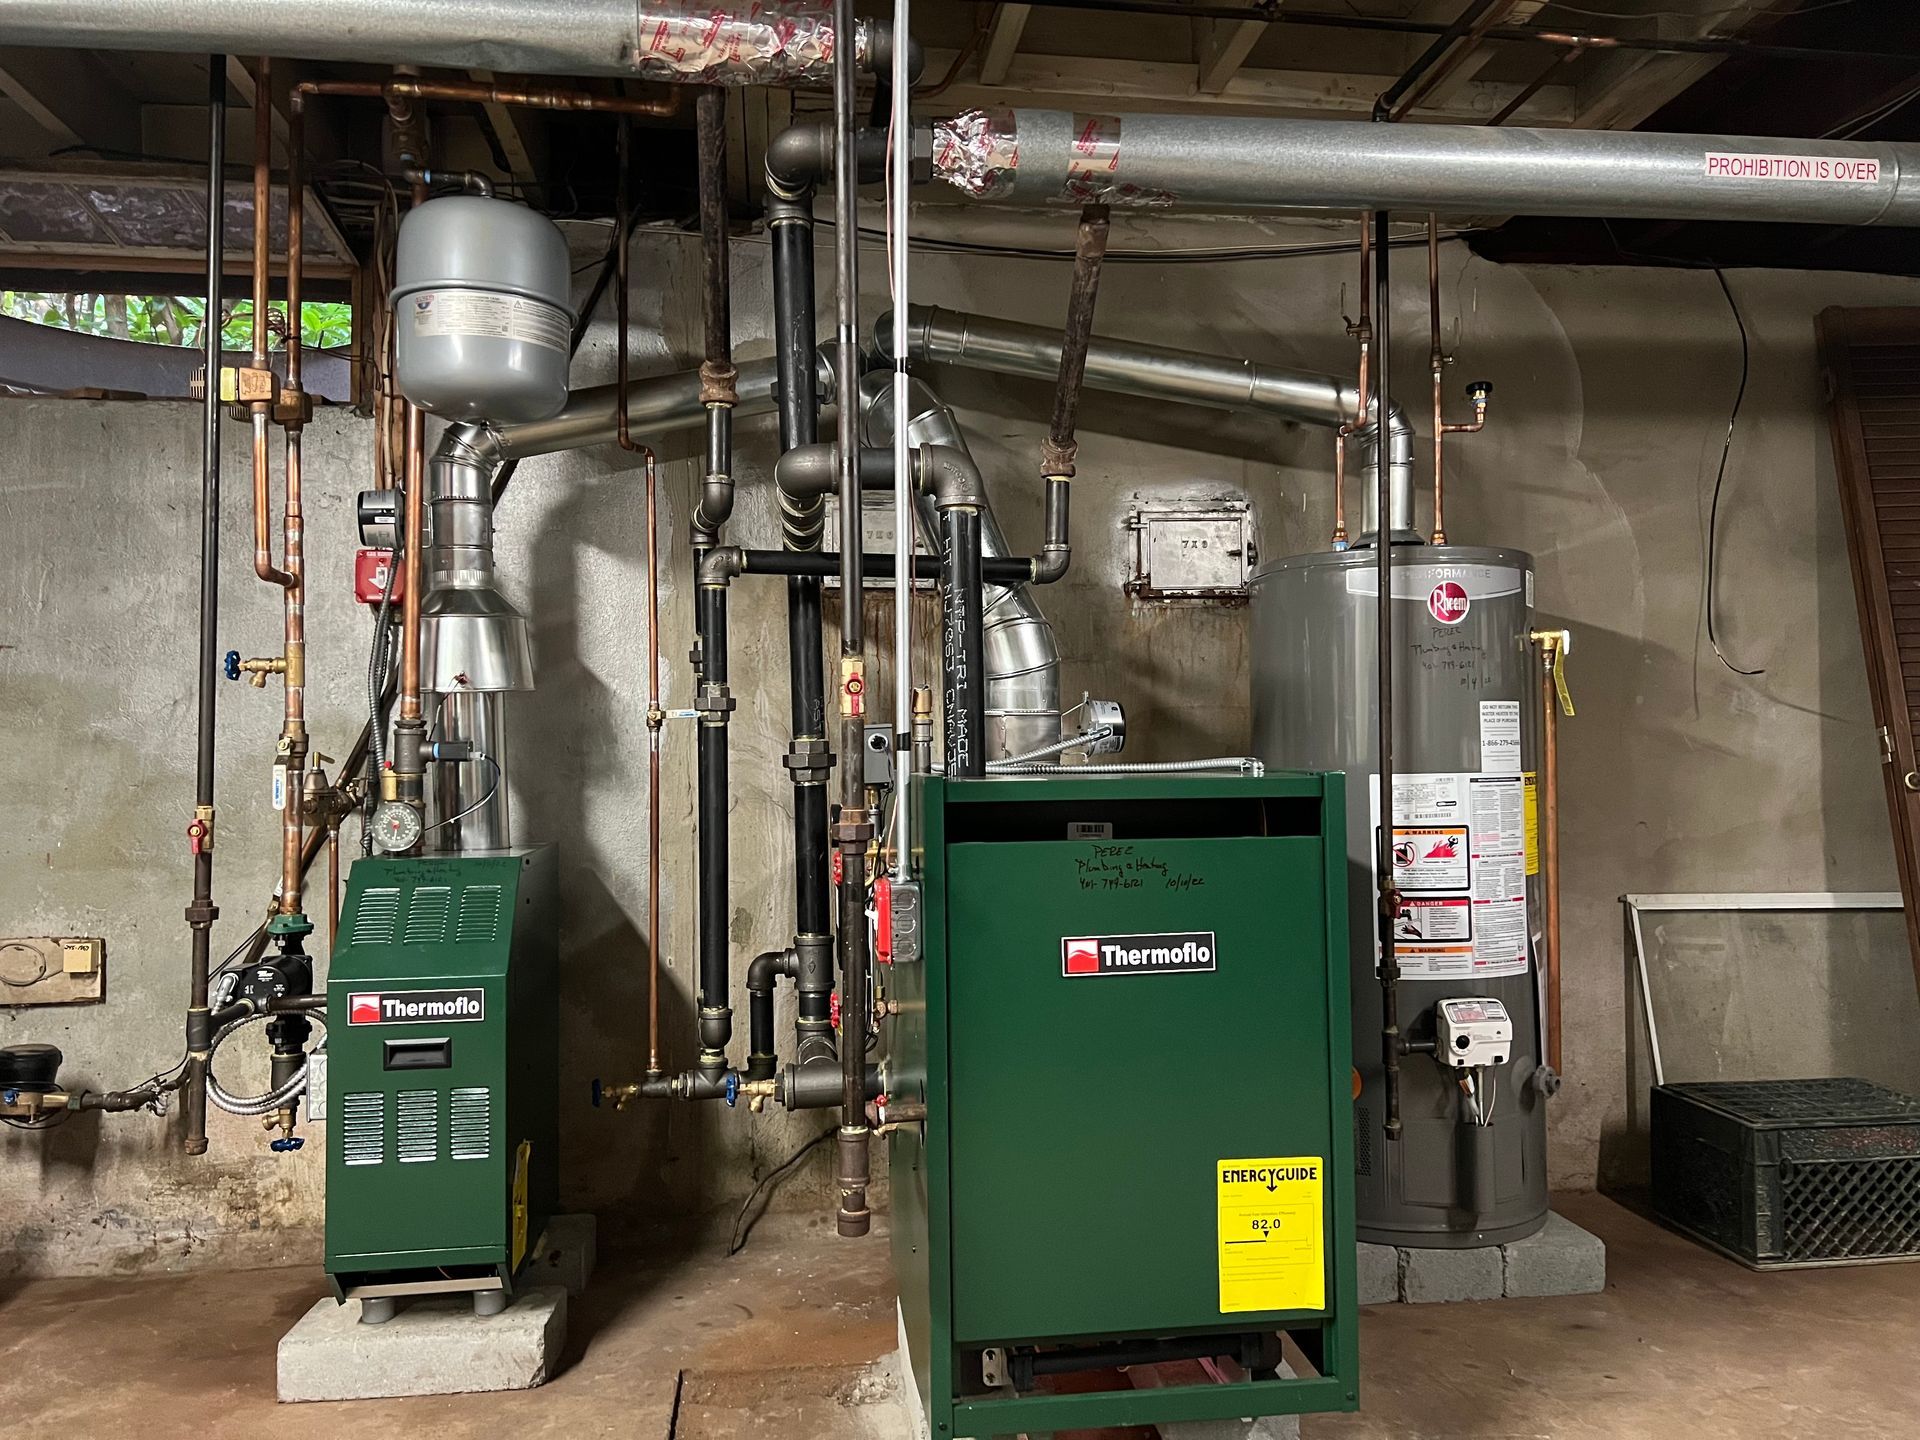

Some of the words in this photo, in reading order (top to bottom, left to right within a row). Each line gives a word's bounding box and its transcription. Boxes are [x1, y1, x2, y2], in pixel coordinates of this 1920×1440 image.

[1708, 157, 1810, 178] PROHIBITION
[1815, 161, 1829, 178] IS
[1834, 162, 1878, 181] OVER
[1433, 581, 1467, 616] Rheem
[1101, 942, 1211, 967] Thermoflo
[382, 996, 480, 1018] Thermoflo
[1222, 1167, 1317, 1185] ENERGYGUIDE
[1252, 1218, 1281, 1230] 82.0
